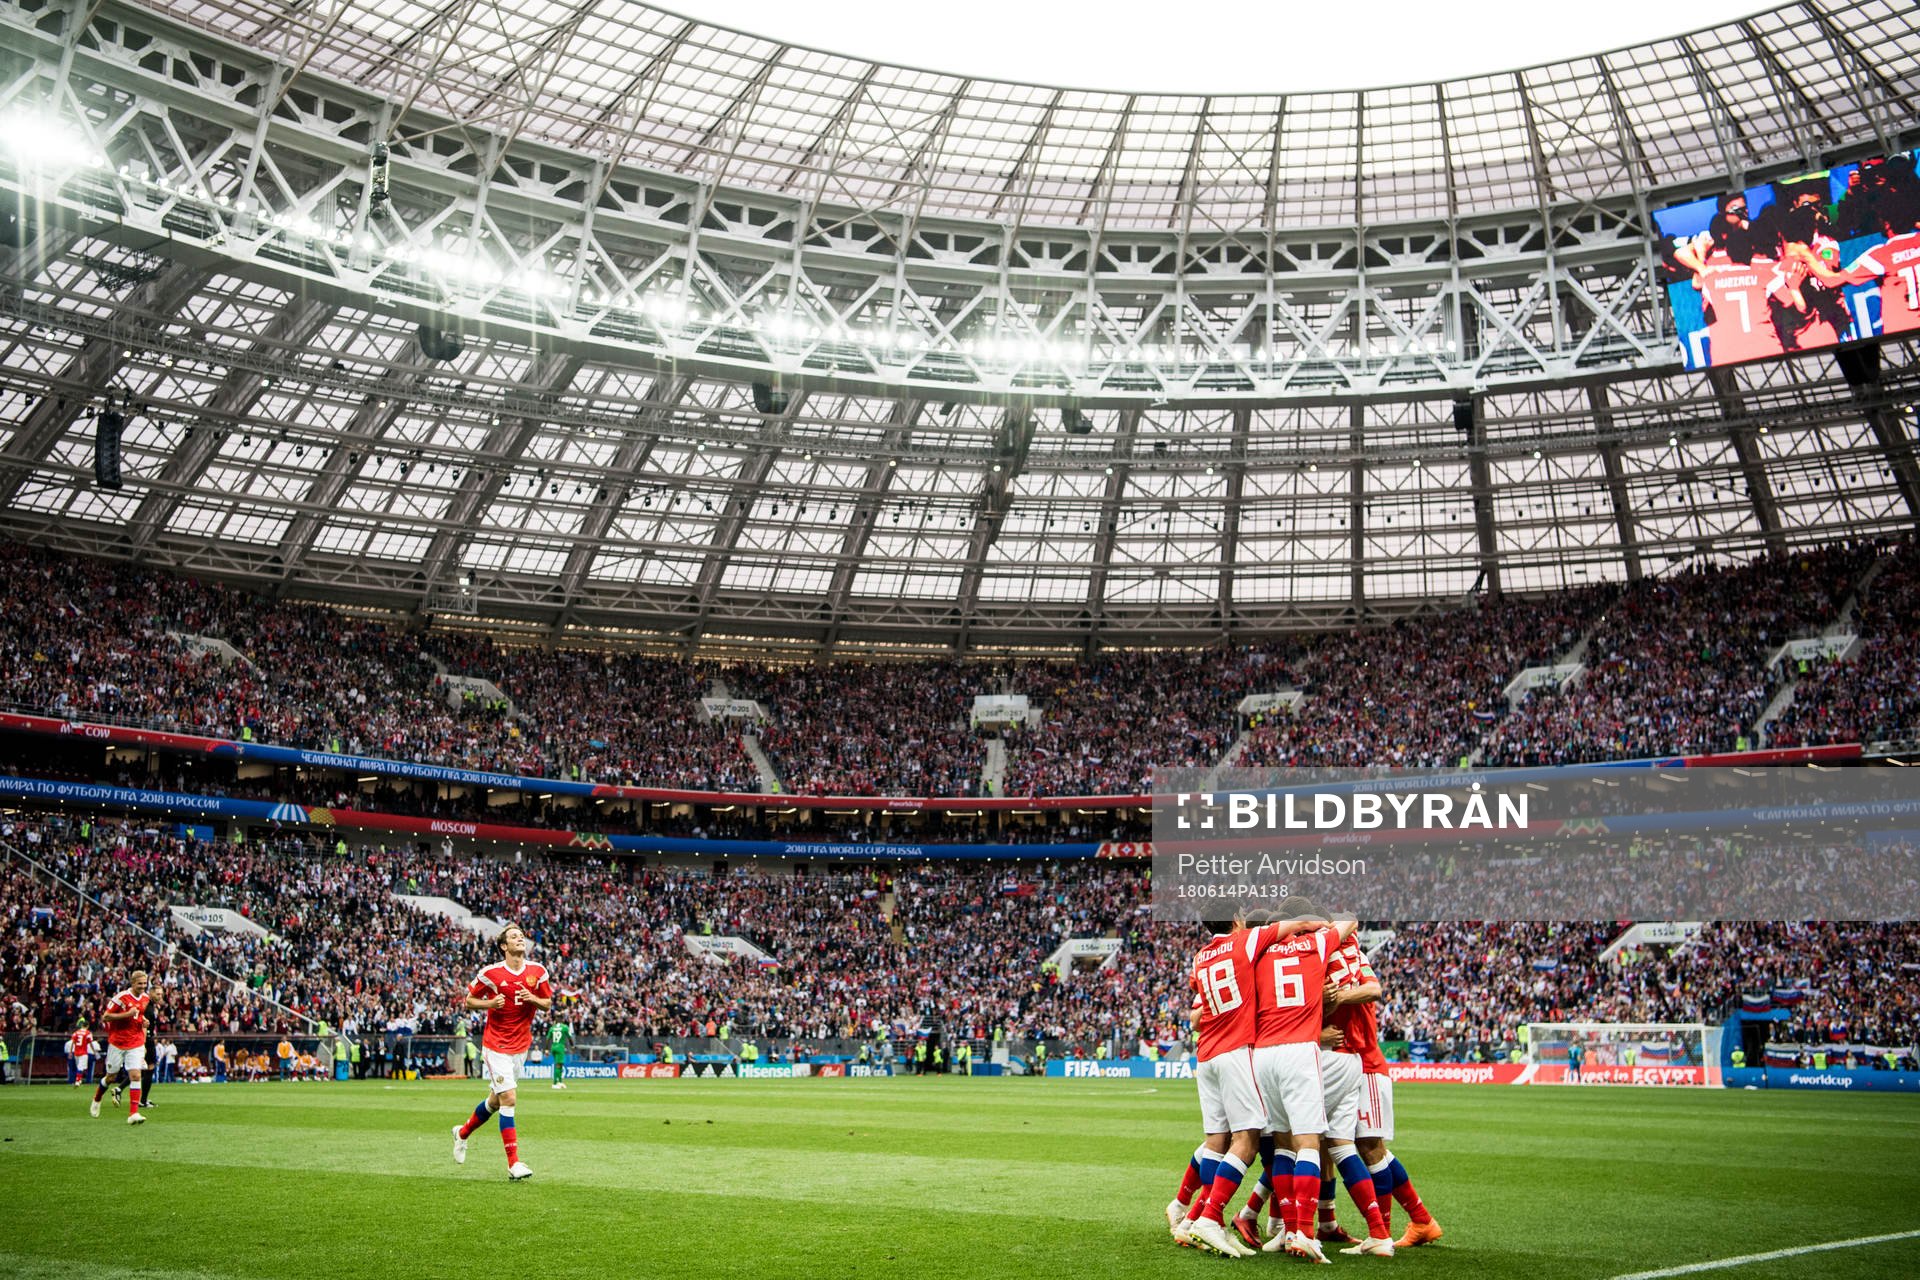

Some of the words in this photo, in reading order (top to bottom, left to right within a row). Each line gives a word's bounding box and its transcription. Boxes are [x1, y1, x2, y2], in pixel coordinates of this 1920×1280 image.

[1725, 290, 1750, 333] 7
[60, 723, 111, 739] MCOW
[301, 753, 357, 768] ЧЕМПИОНАТ
[359, 760, 385, 772] МИРА
[387, 764, 400, 774] ПО
[402, 765, 442, 779] ФУТБОЛУ
[443, 770, 461, 781] FIFA
[462, 772, 480, 783] 2018
[488, 775, 521, 788] РОССИИ
[1374, 781, 1394, 792] FIFA
[1395, 779, 1428, 790] WORLD
[1429, 776, 1450, 787] CUP
[1451, 775, 1487, 786] RUSSIA
[37, 783, 55, 795] ПО
[57, 785, 112, 799] ФУТБОЛУ
[114, 789, 137, 802] FIFA
[140, 792, 164, 804] 2018
[176, 796, 220, 810] РОССИИ
[1752, 807, 1828, 820] ЧЕМПИОНАТ
[1831, 804, 1869, 816] МИРА
[1871, 803, 1890, 815] ПО
[431, 821, 477, 835] MOSCOW
[1322, 833, 1371, 844] #worldcup
[785, 844, 807, 854] 2018
[808, 845, 828, 854] FIFA
[829, 845, 864, 855] WORLD
[865, 845, 885, 855] CUP
[886, 846, 922, 856] RUSSIA
[1198, 958, 1243, 1016] 18
[1274, 957, 1305, 1008] 6
[76, 1034, 83, 1046] 3
[552, 1031, 562, 1043] 19
[739, 1064, 792, 1077] Hisense
[1064, 1061, 1131, 1078] FIFA.com
[1632, 1068, 1698, 1085] EGYPT
[1789, 1074, 1853, 1088] #worldcup
